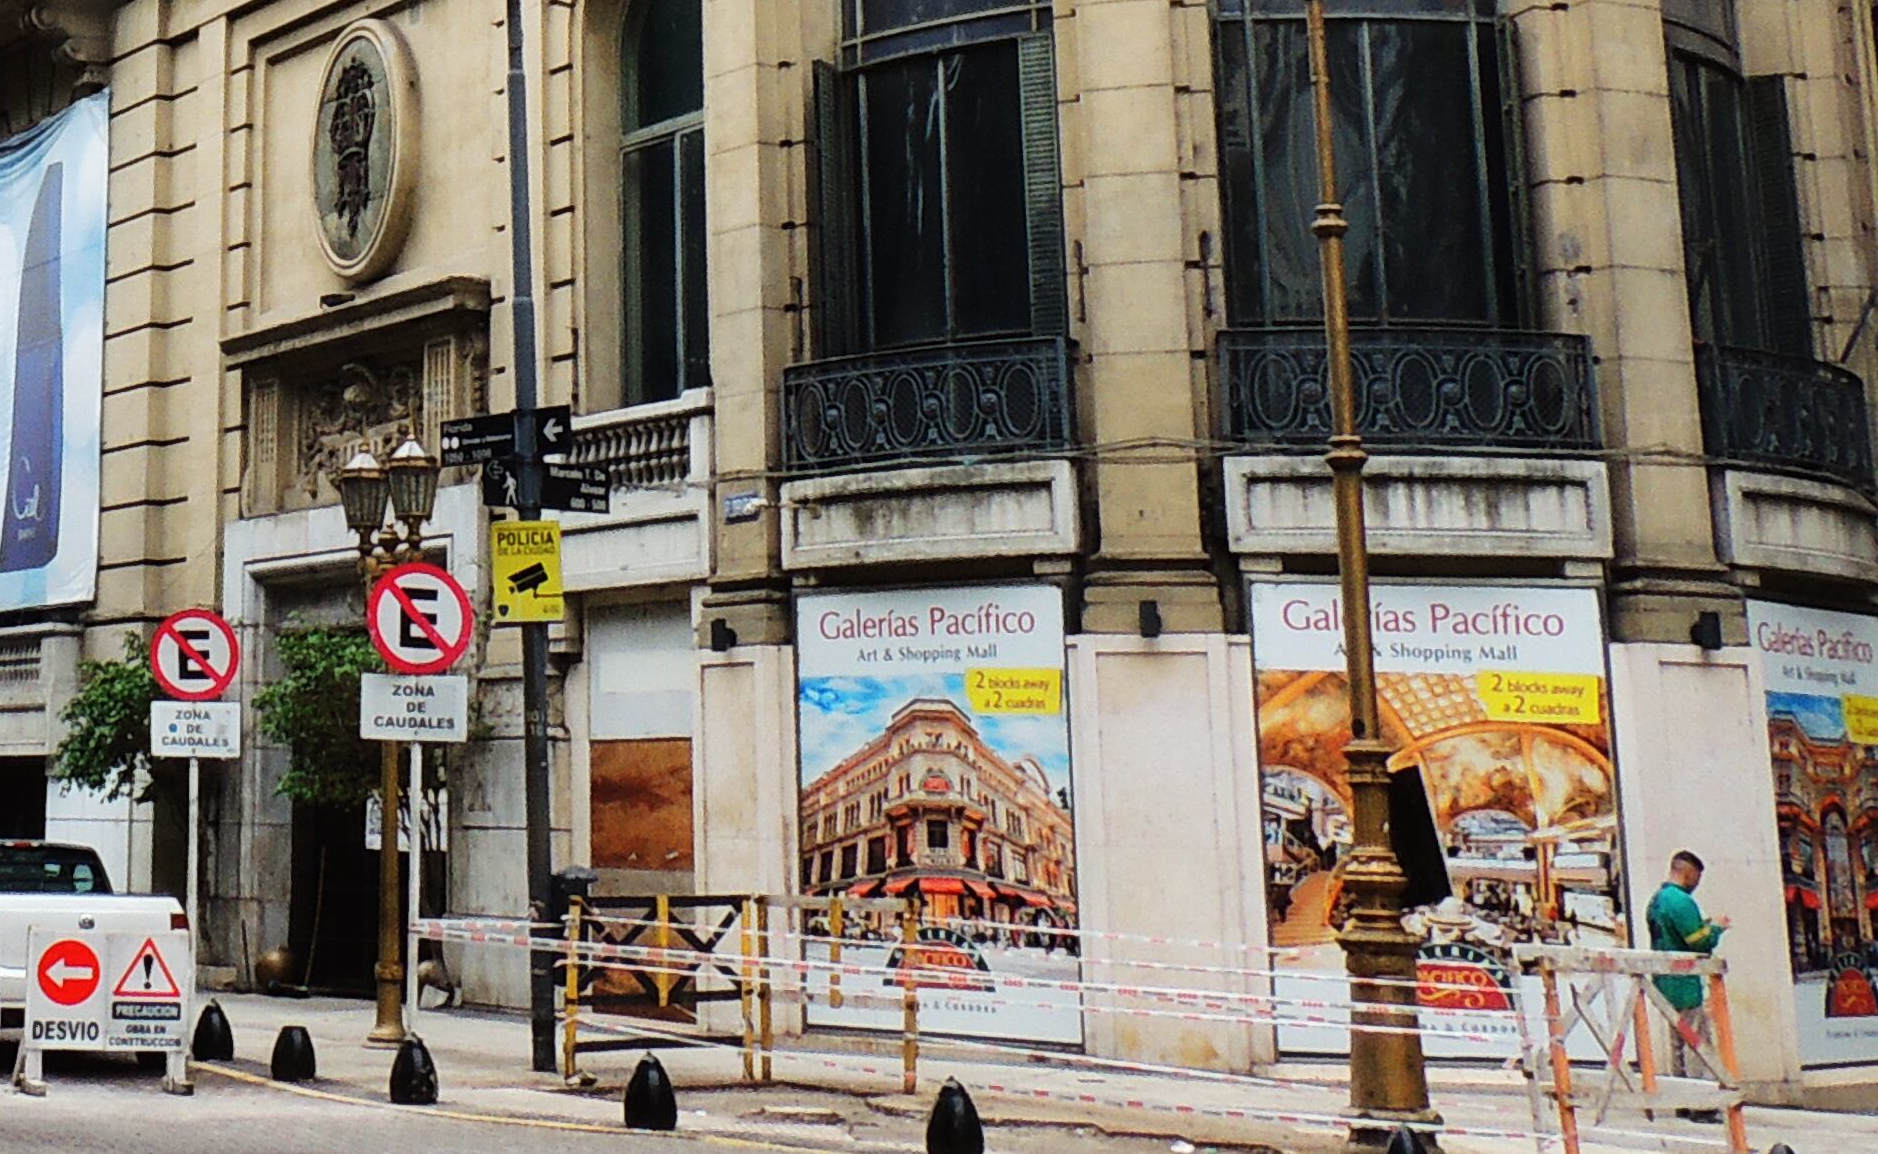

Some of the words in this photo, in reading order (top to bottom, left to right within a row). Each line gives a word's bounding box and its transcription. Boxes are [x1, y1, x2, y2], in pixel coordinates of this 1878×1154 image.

[497, 531, 555, 546] POLICIA
[400, 587, 438, 649] E
[820, 608, 919, 639] Galerías
[930, 602, 1036, 635] Pacífico
[1282, 598, 1416, 633] Galías
[1429, 603, 1565, 637] Pacífico
[178, 630, 210, 680] E
[857, 648, 878, 662] Art
[883, 647, 893, 662] &
[898, 645, 961, 663] Shopping
[966, 643, 997, 658] Mall
[1390, 643, 1473, 663] Shopping
[1478, 644, 1518, 661] Mall
[976, 670, 985, 688] 2
[1492, 673, 1502, 692] 2
[392, 684, 435, 697] ZONA
[993, 690, 1002, 709] 2
[406, 701, 427, 713] DE
[1513, 695, 1526, 713] 2
[175, 709, 211, 721] ZONA
[373, 715, 455, 730] CAUDALES
[186, 724, 203, 735] DE
[161, 735, 230, 747] CAUDALES
[32, 1020, 100, 1041] DESVIO
